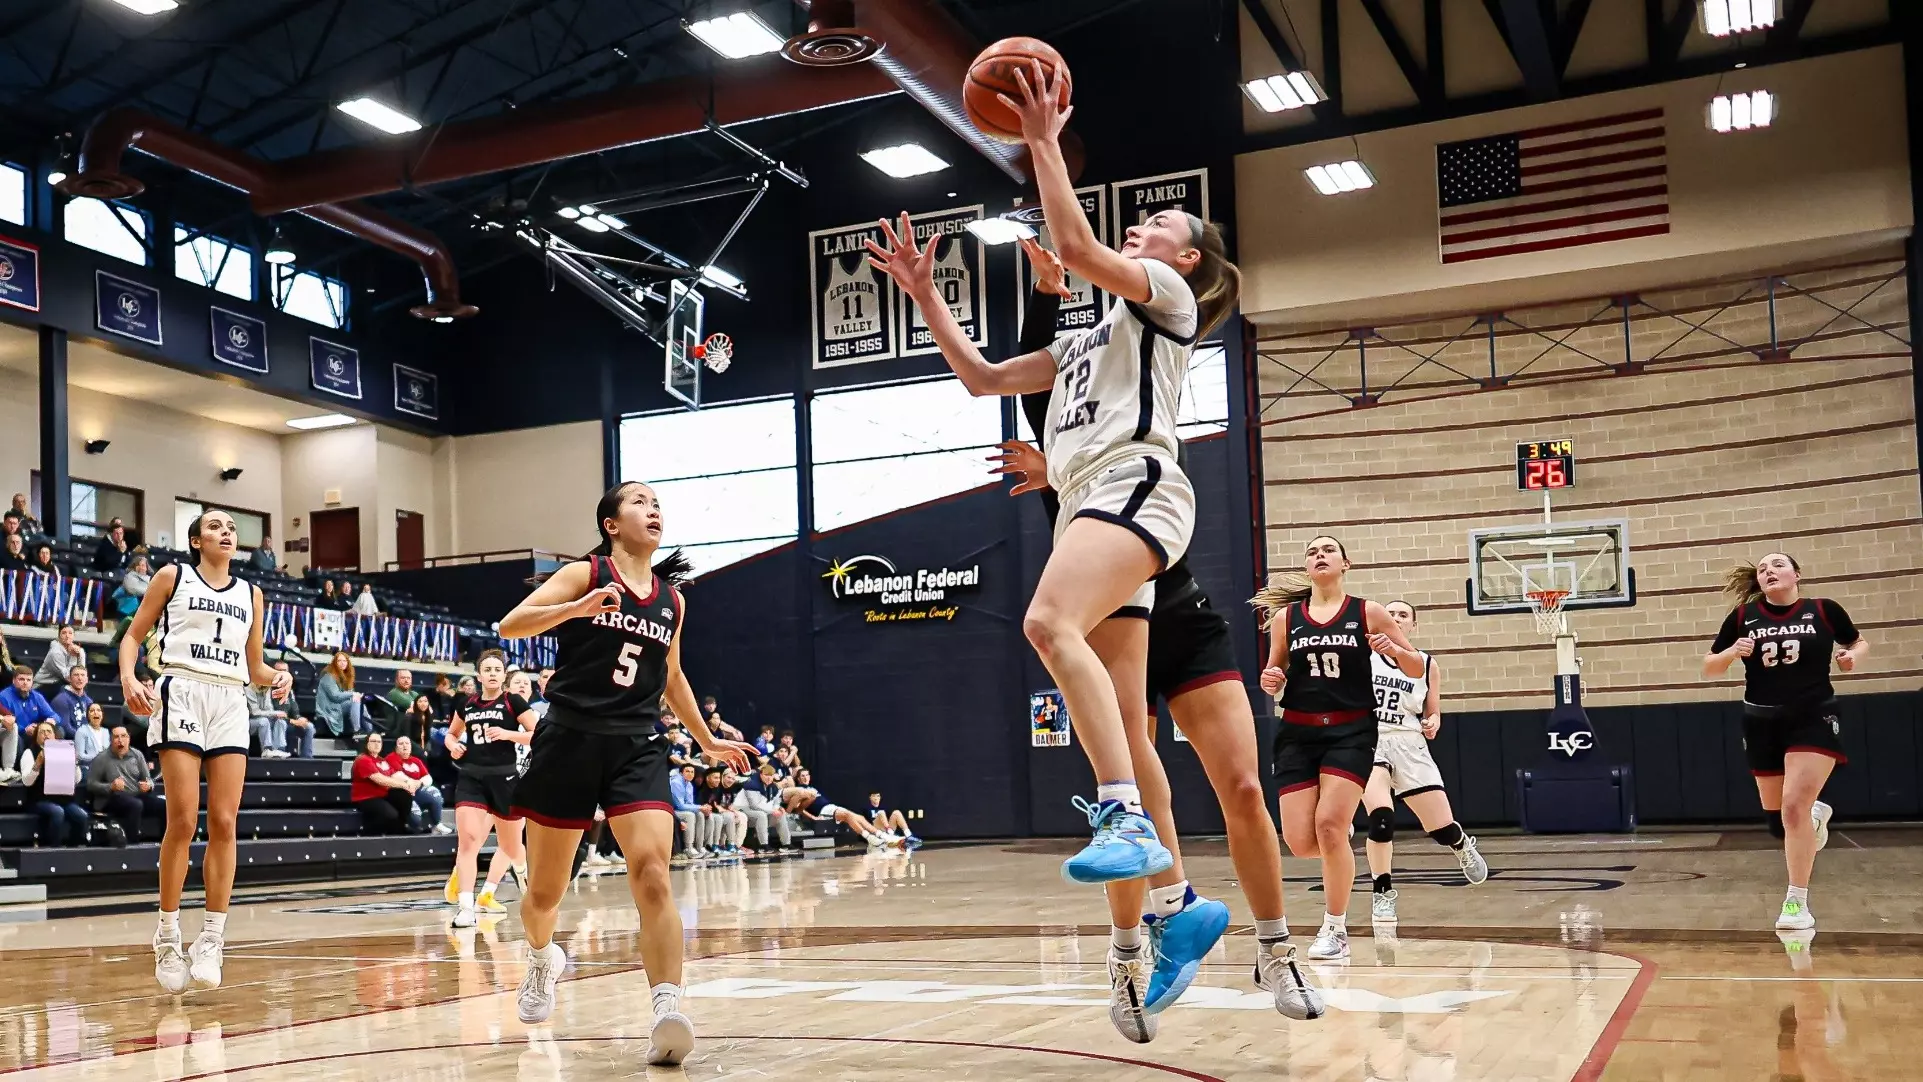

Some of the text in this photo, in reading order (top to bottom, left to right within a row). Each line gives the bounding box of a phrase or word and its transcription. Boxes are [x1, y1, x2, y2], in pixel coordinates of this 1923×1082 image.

[1136, 183, 1186, 205] PANKO
[830, 281, 875, 301] LEBANON
[842, 294, 864, 320] 11
[834, 320, 873, 335] VALLEY
[825, 337, 883, 358] 1951-1955
[1527, 460, 1565, 489] 26
[844, 565, 979, 595] Lebanon Federal
[881, 588, 944, 604] Credit Union
[188, 596, 248, 624] LEBANON
[899, 609, 926, 620] Lebanon
[213, 617, 223, 644] 1
[592, 612, 672, 646] ARCADIA
[1747, 624, 1817, 640] ARCADIA
[190, 643, 240, 667] VALLEY
[1289, 634, 1359, 652] ARCADIA
[1761, 640, 1800, 667] 23
[612, 641, 644, 688] 5
[1307, 653, 1341, 679] 10
[1375, 688, 1401, 711] 32
[178, 719, 201, 735] LVC
[1547, 731, 1593, 757] LVC
